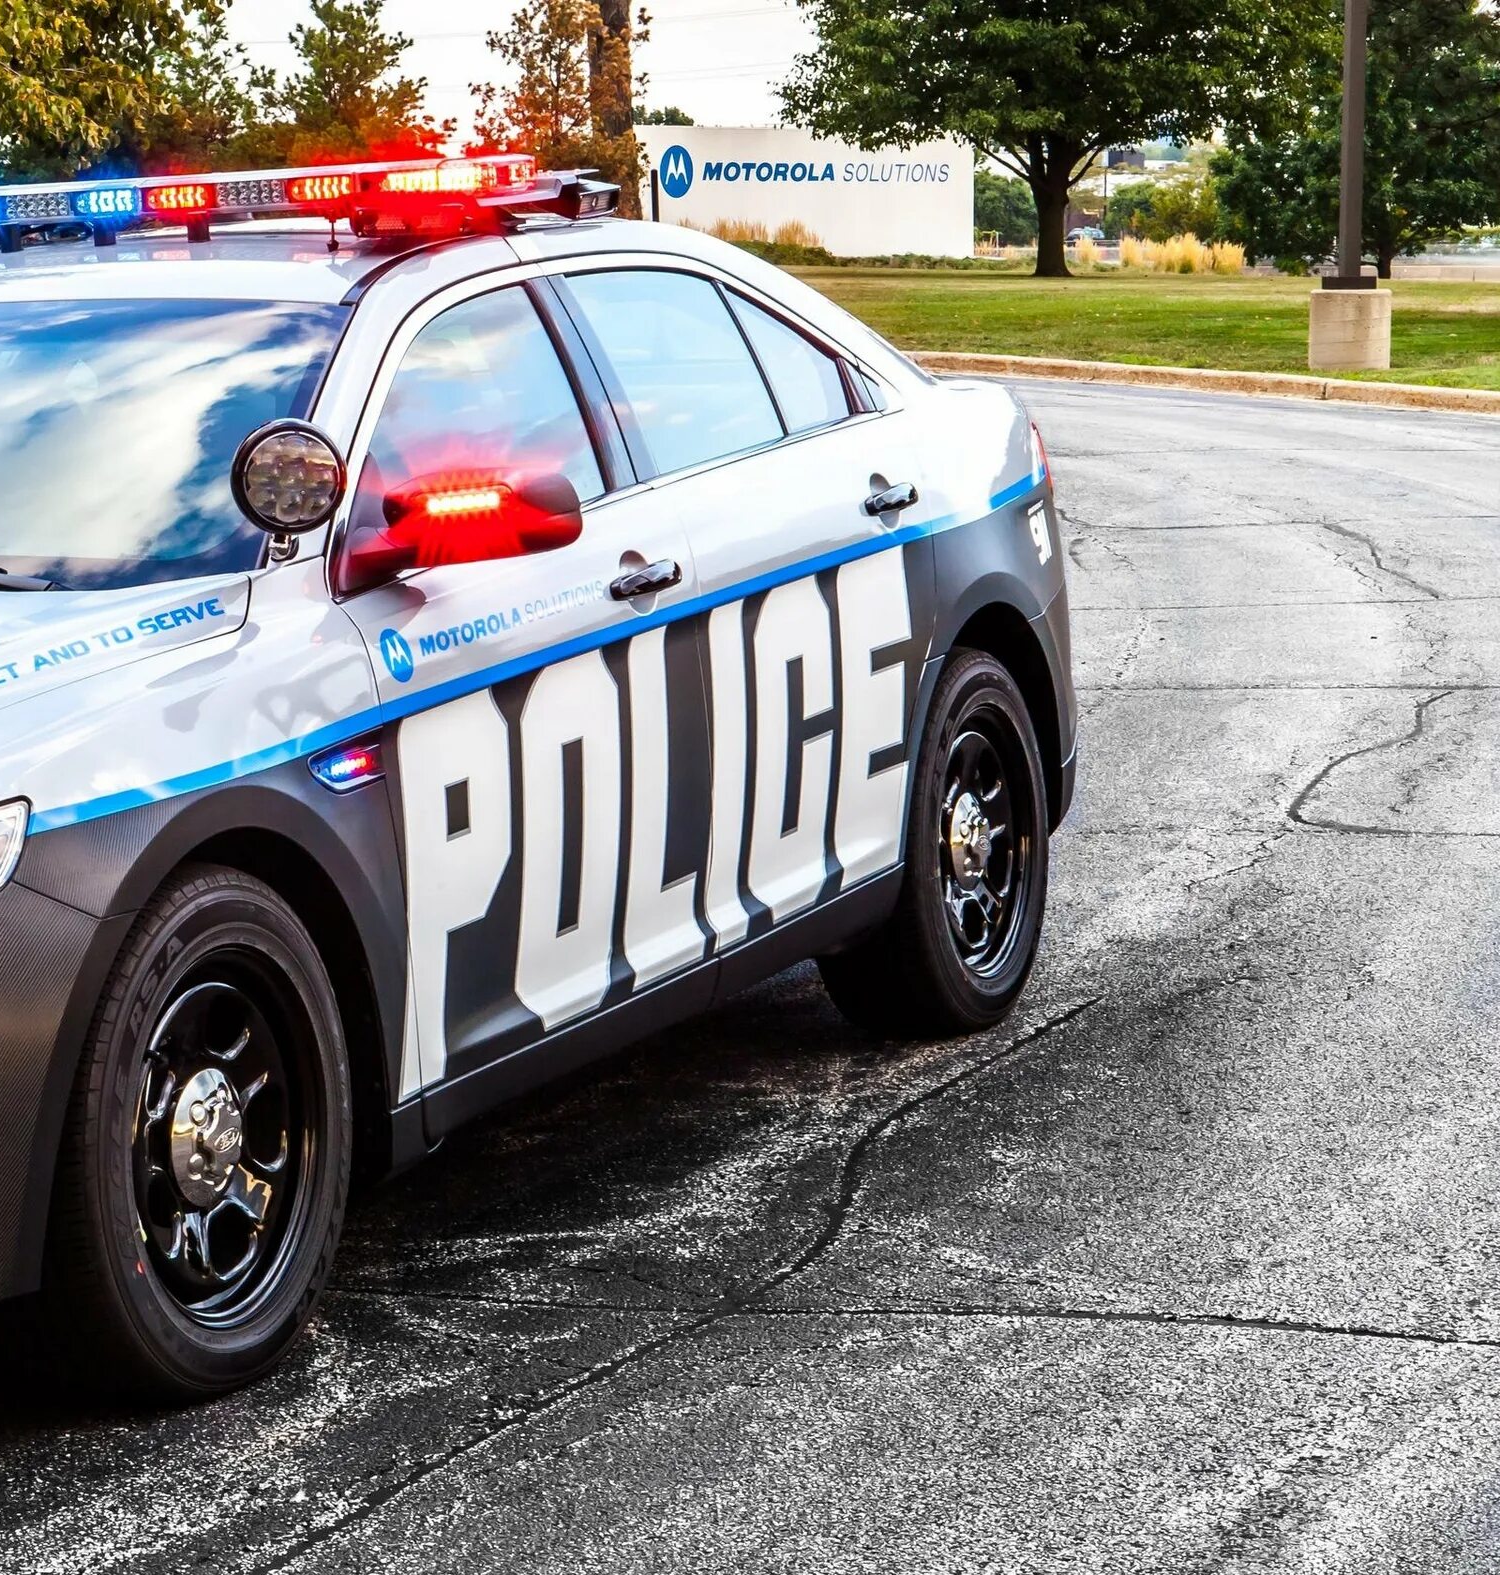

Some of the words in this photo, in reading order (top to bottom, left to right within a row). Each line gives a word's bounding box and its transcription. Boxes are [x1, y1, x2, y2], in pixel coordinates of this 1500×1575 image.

[702, 161, 835, 182] MOTOROLA
[842, 163, 950, 183] SOLUTIONS
[33, 639, 92, 673] AND
[92, 626, 134, 649] TO
[136, 598, 225, 636] SERVE
[419, 609, 523, 657] MOTOROLA
[524, 580, 606, 623] SOLUTIONS
[397, 545, 911, 1104] POLICE
